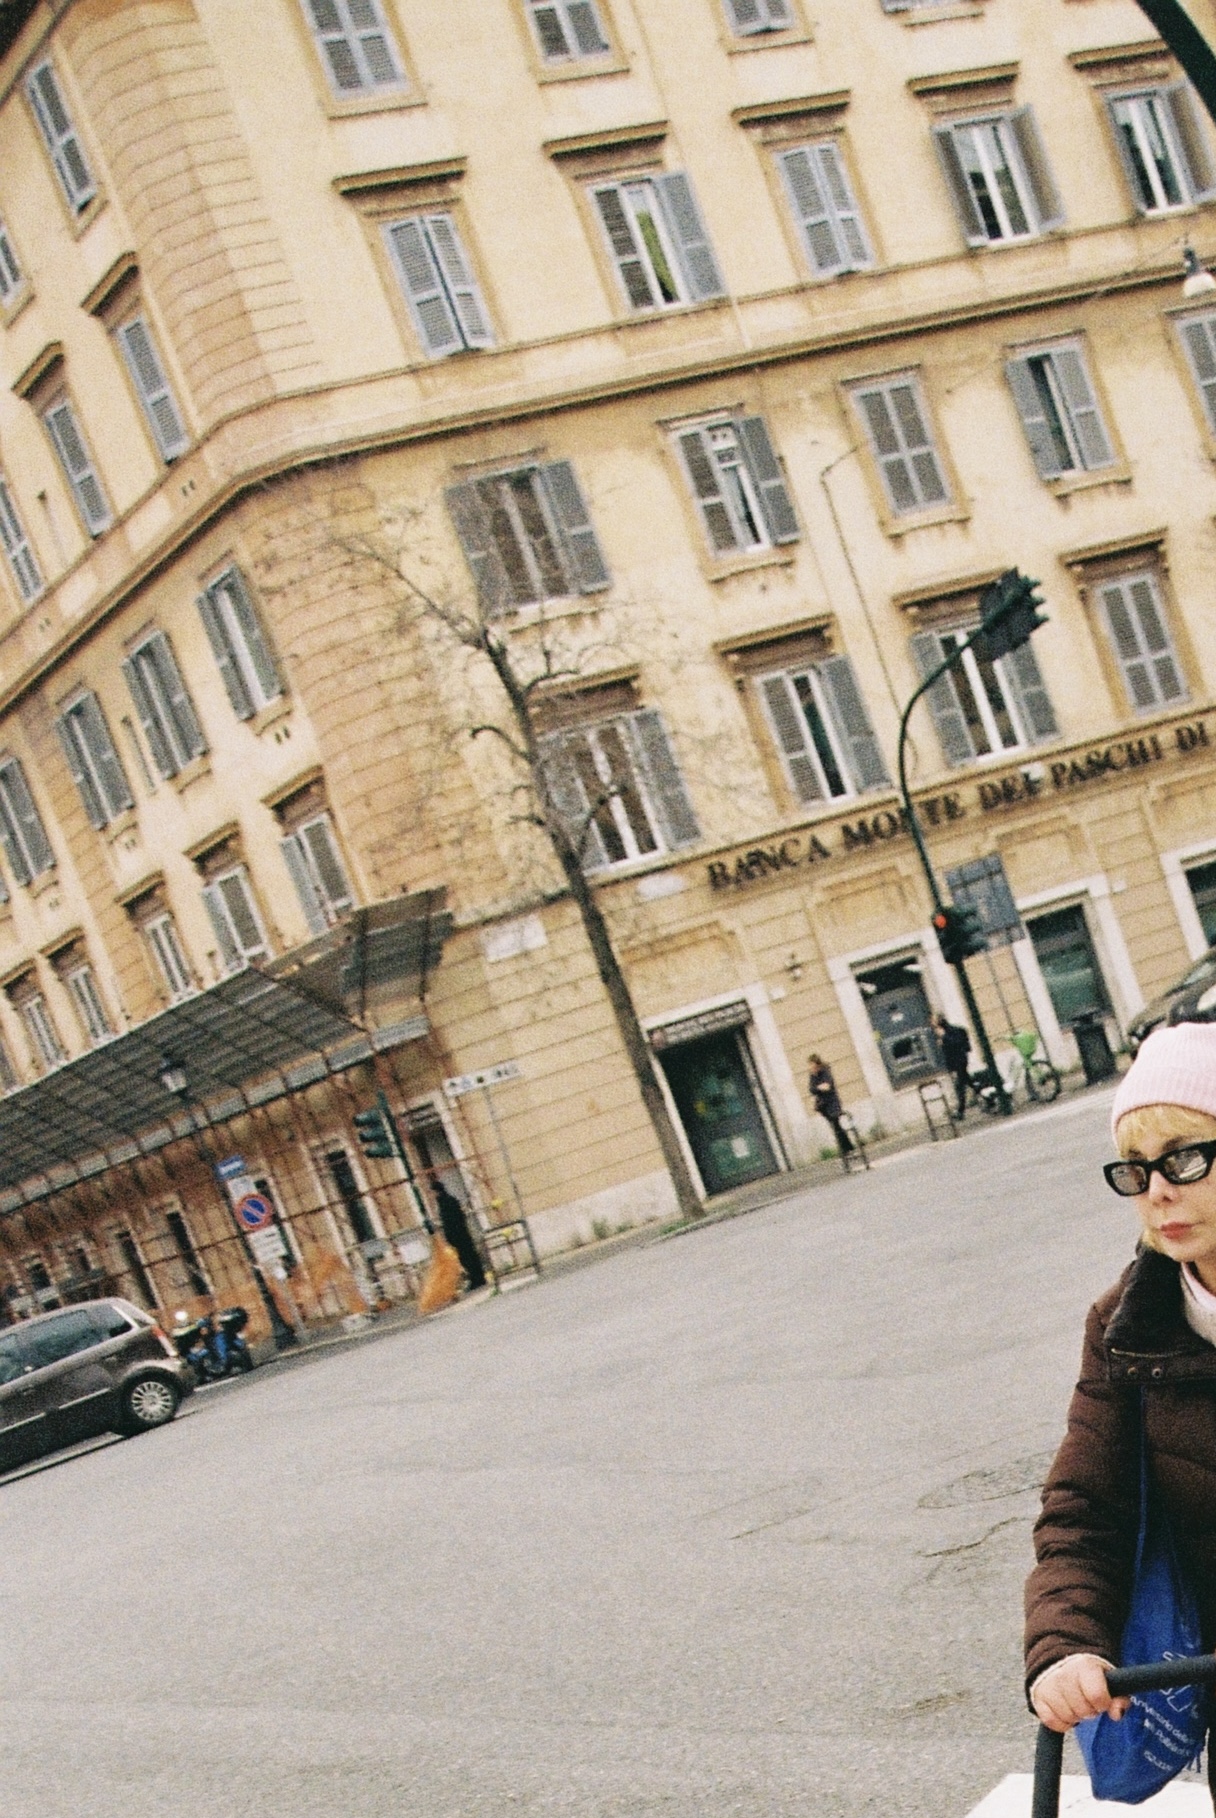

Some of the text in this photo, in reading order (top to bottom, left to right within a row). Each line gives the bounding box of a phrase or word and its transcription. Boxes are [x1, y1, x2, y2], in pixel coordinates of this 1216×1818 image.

[707, 834, 831, 891] BANCA
[1050, 733, 1163, 790] PASCHI
[1174, 722, 1210, 754] DI
